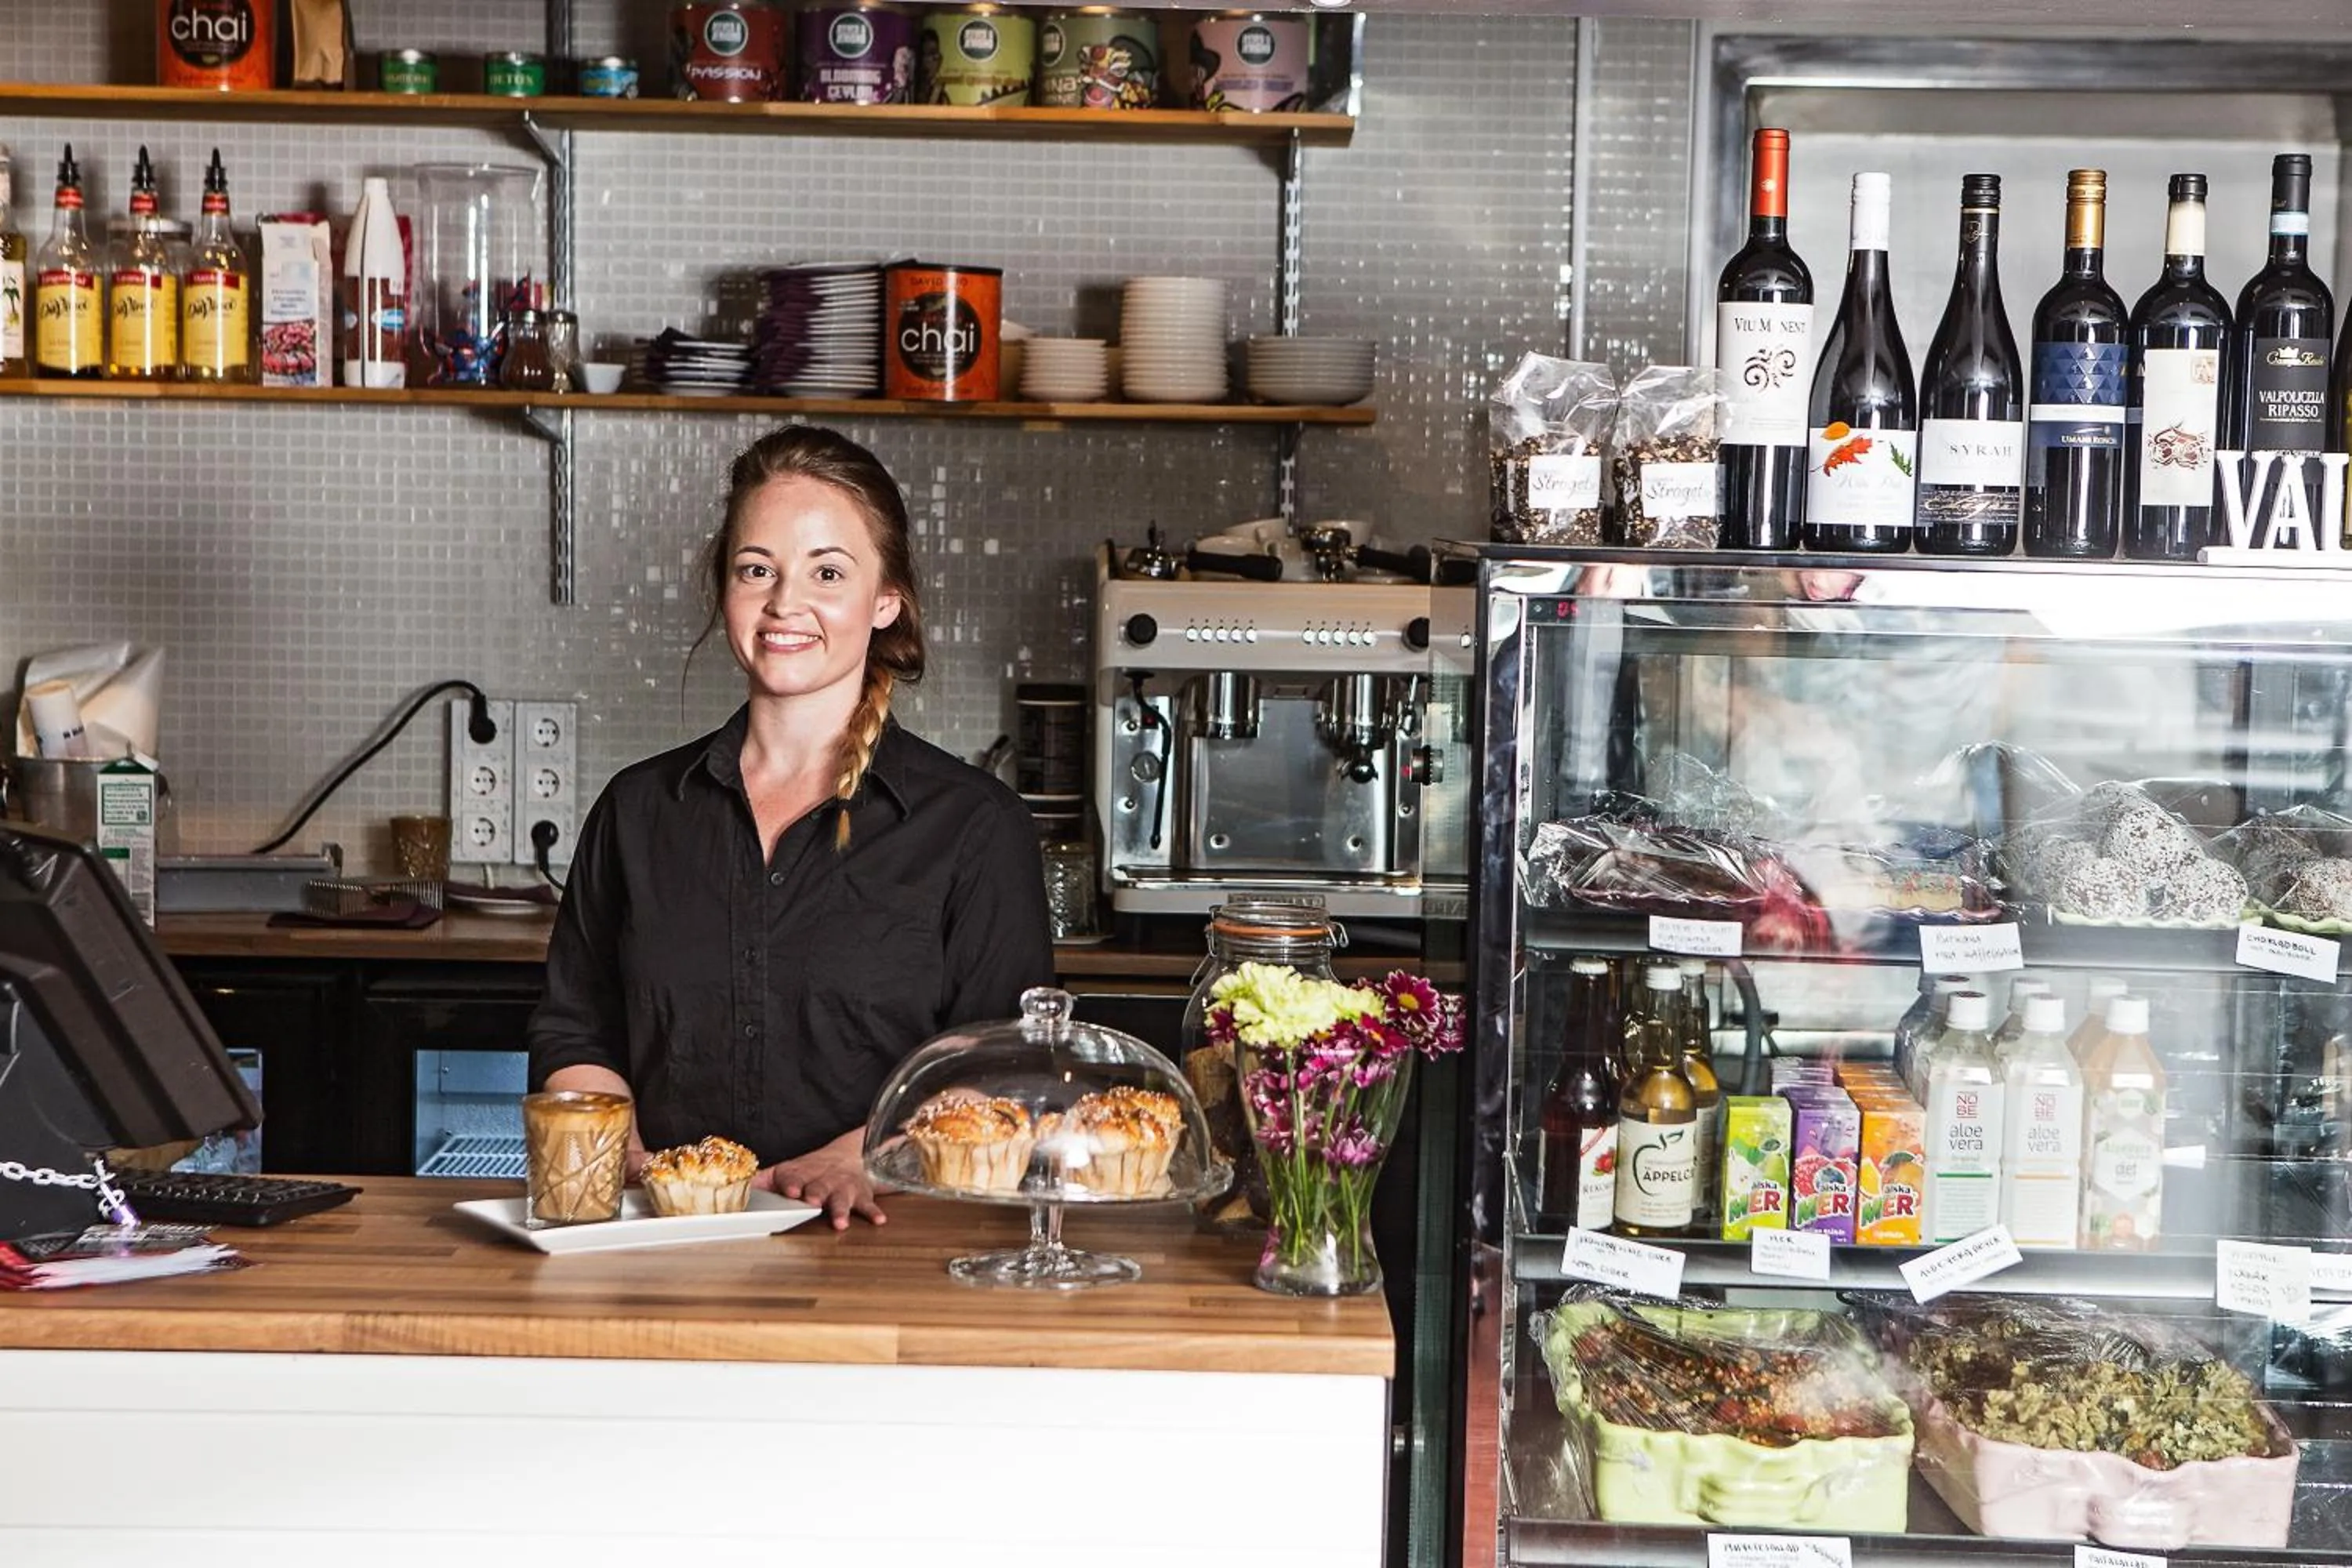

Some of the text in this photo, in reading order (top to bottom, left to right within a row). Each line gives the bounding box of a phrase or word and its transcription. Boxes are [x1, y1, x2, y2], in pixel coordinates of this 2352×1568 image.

[172, 8, 247, 42] chai
[690, 65, 762, 80] PASSION
[909, 277, 944, 287] DAVID
[1758, 318, 1806, 333] MNENT
[901, 321, 975, 353] chai
[2259, 390, 2325, 404] VALPOLICELLA
[2268, 404, 2318, 417] RIPASSO
[1950, 1123, 1983, 1138] aloe
[2028, 1124, 2060, 1139] aloe
[1949, 1139, 1983, 1150] vera
[2027, 1141, 2061, 1152] vera
